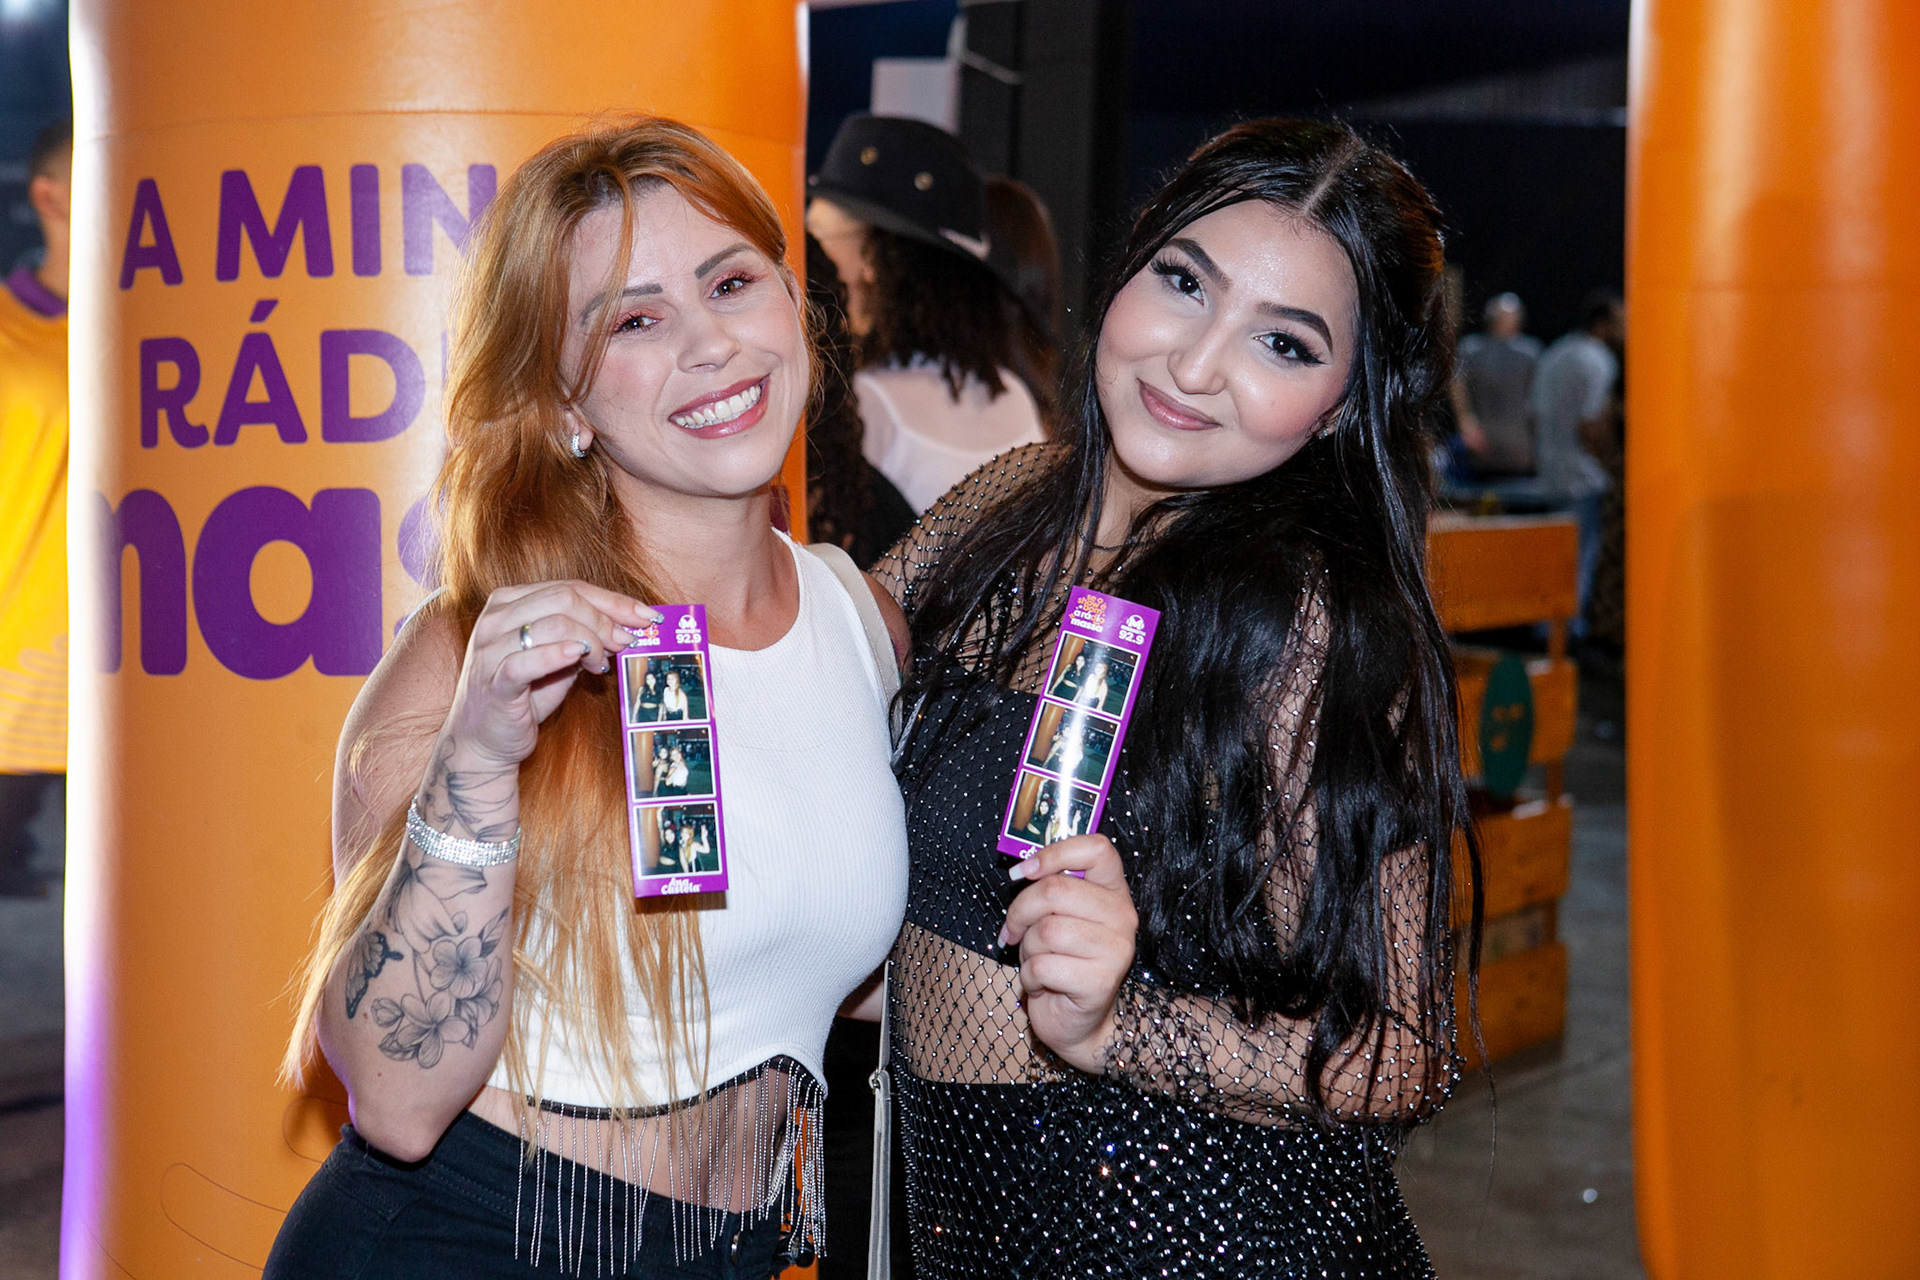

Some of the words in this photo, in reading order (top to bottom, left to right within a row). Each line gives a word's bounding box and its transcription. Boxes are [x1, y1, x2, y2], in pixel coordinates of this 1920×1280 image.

[119, 178, 183, 290] A
[140, 299, 448, 449] RÁD
[1070, 618, 1103, 633] massa
[676, 633, 702, 644] 92.9
[1118, 630, 1145, 645] 92.9
